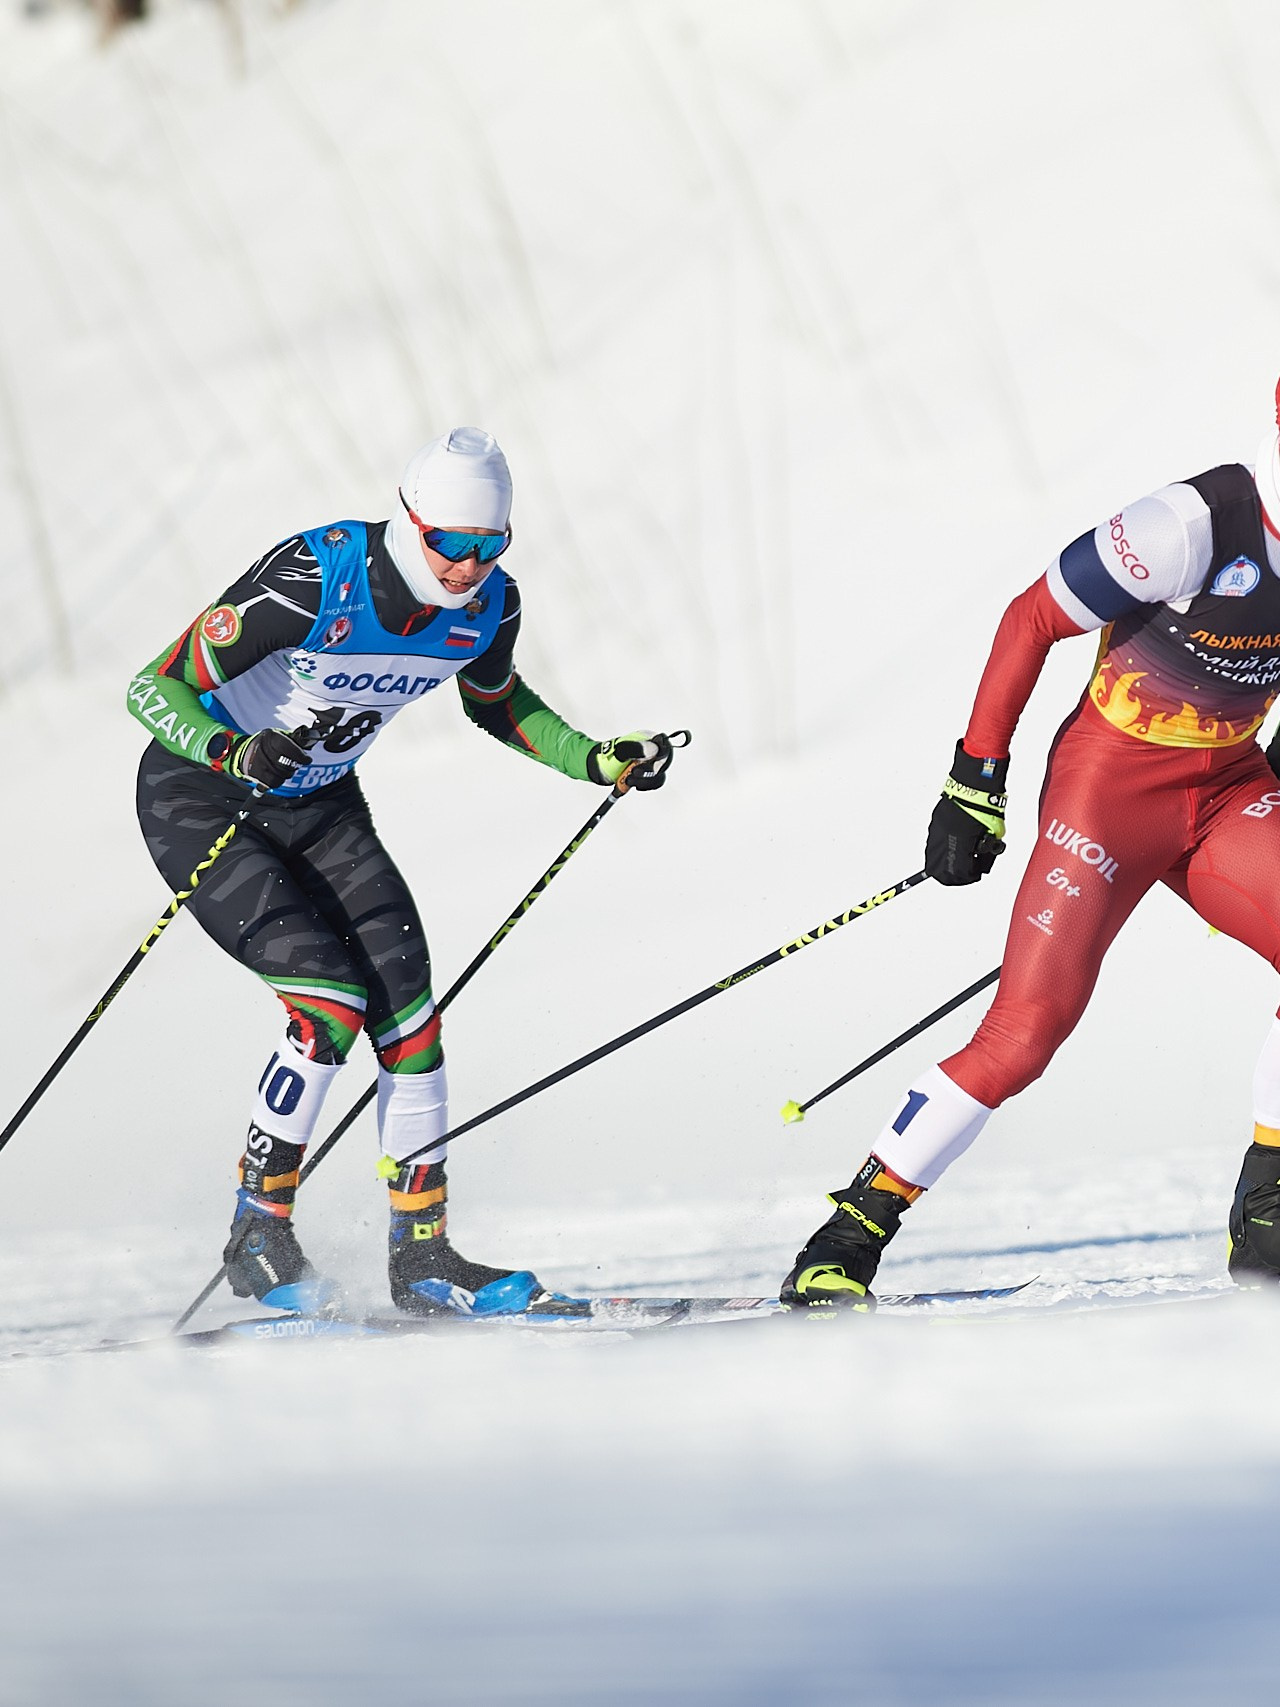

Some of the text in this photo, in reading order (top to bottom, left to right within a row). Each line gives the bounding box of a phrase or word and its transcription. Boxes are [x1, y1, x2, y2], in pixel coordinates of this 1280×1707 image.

[322, 672, 441, 695] ФОСАГР
[129, 674, 197, 750] KAZAN
[1045, 818, 1119, 884] LUKOIL
[892, 1089, 930, 1137] 1
[255, 1320, 315, 1340] salomon
